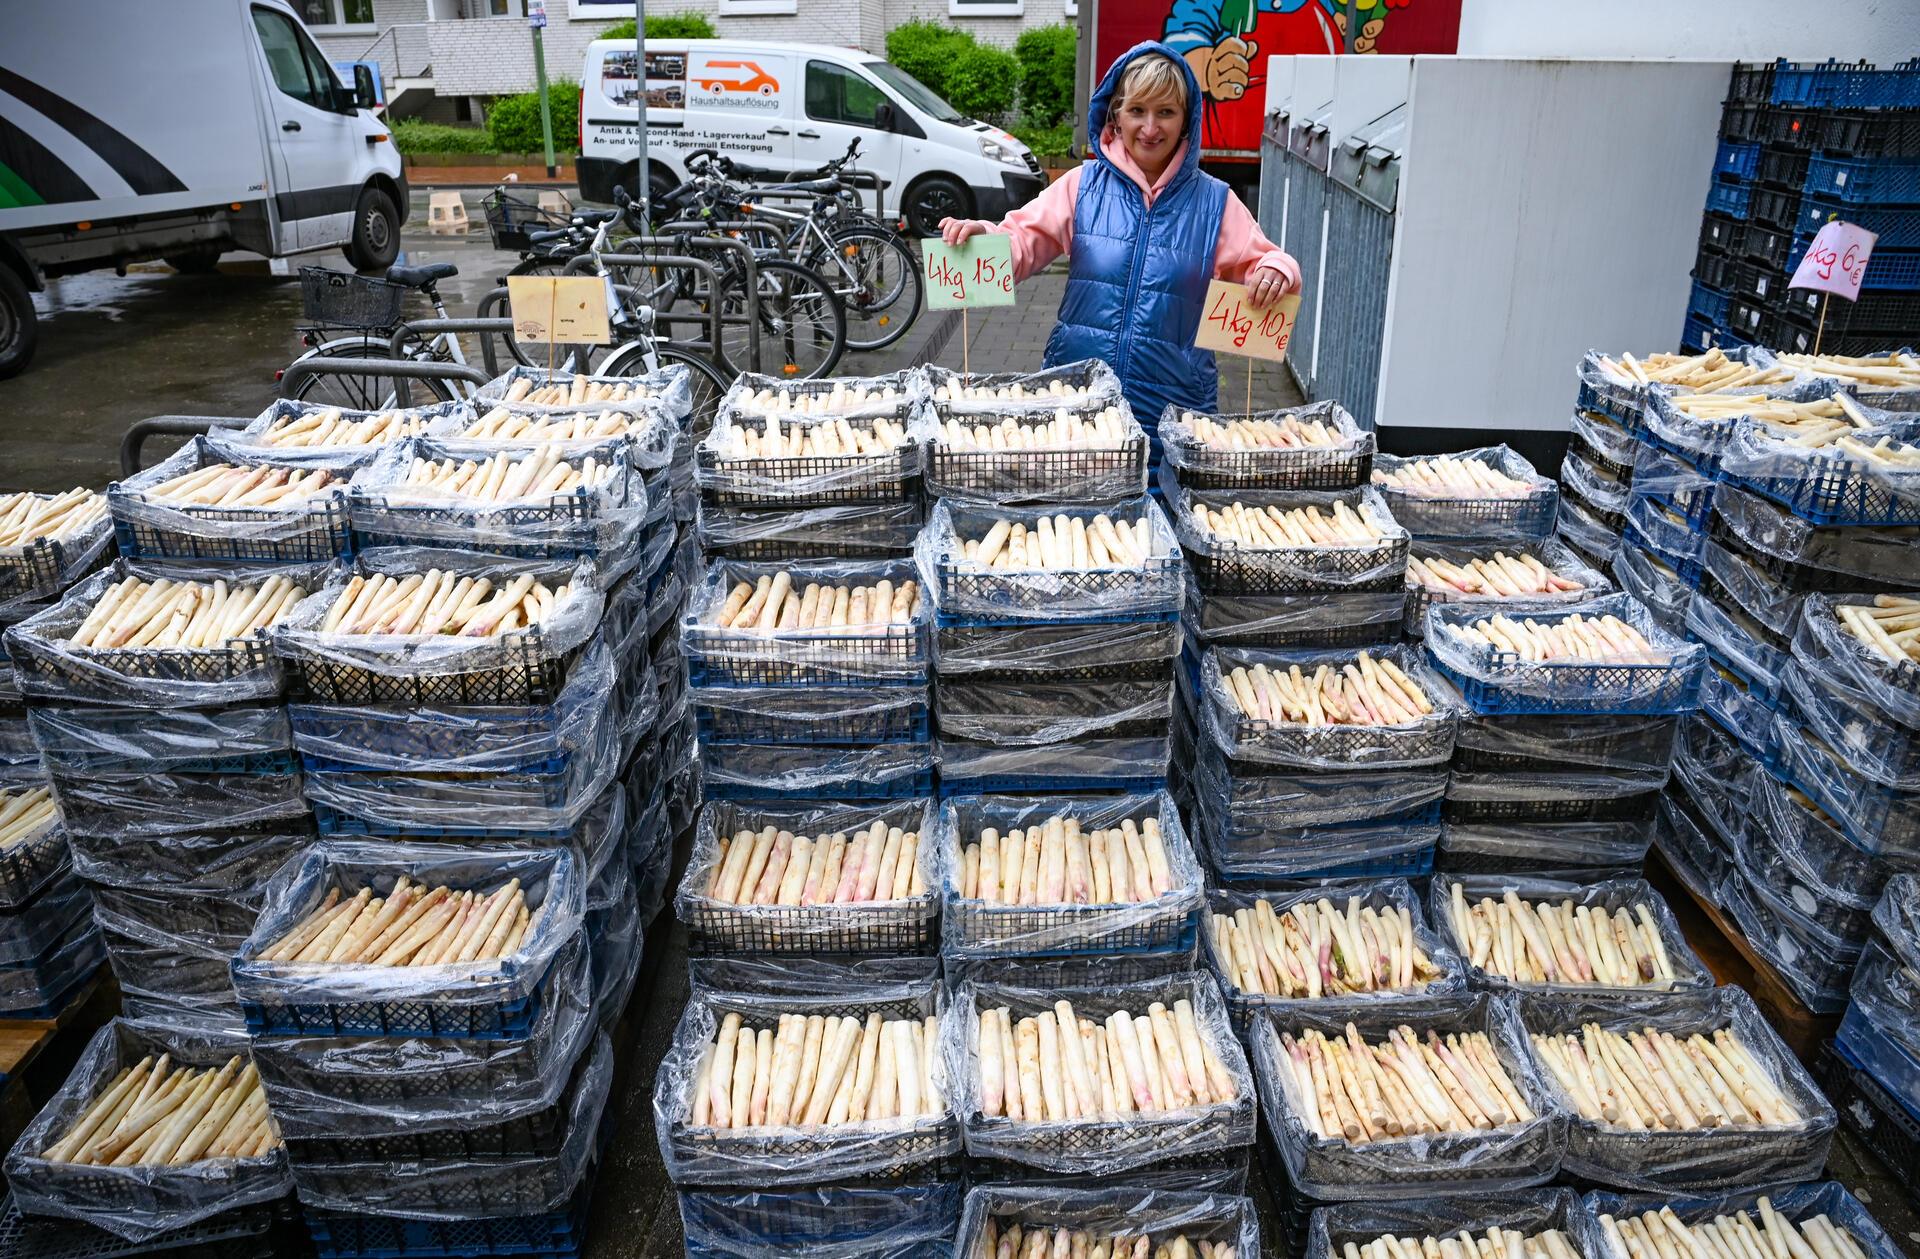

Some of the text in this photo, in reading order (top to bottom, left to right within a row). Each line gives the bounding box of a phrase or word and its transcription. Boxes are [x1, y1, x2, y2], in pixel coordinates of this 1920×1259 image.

[690, 95, 779, 109] Haushaltsauflösung
[600, 126, 623, 134] Antik
[625, 127, 632, 135] &
[703, 131, 766, 140] Lagerverkauf
[593, 136, 607, 144] An-
[628, 138, 663, 146] Veauf
[673, 140, 717, 149] Sperrmüll
[720, 142, 773, 152] Entsorgung
